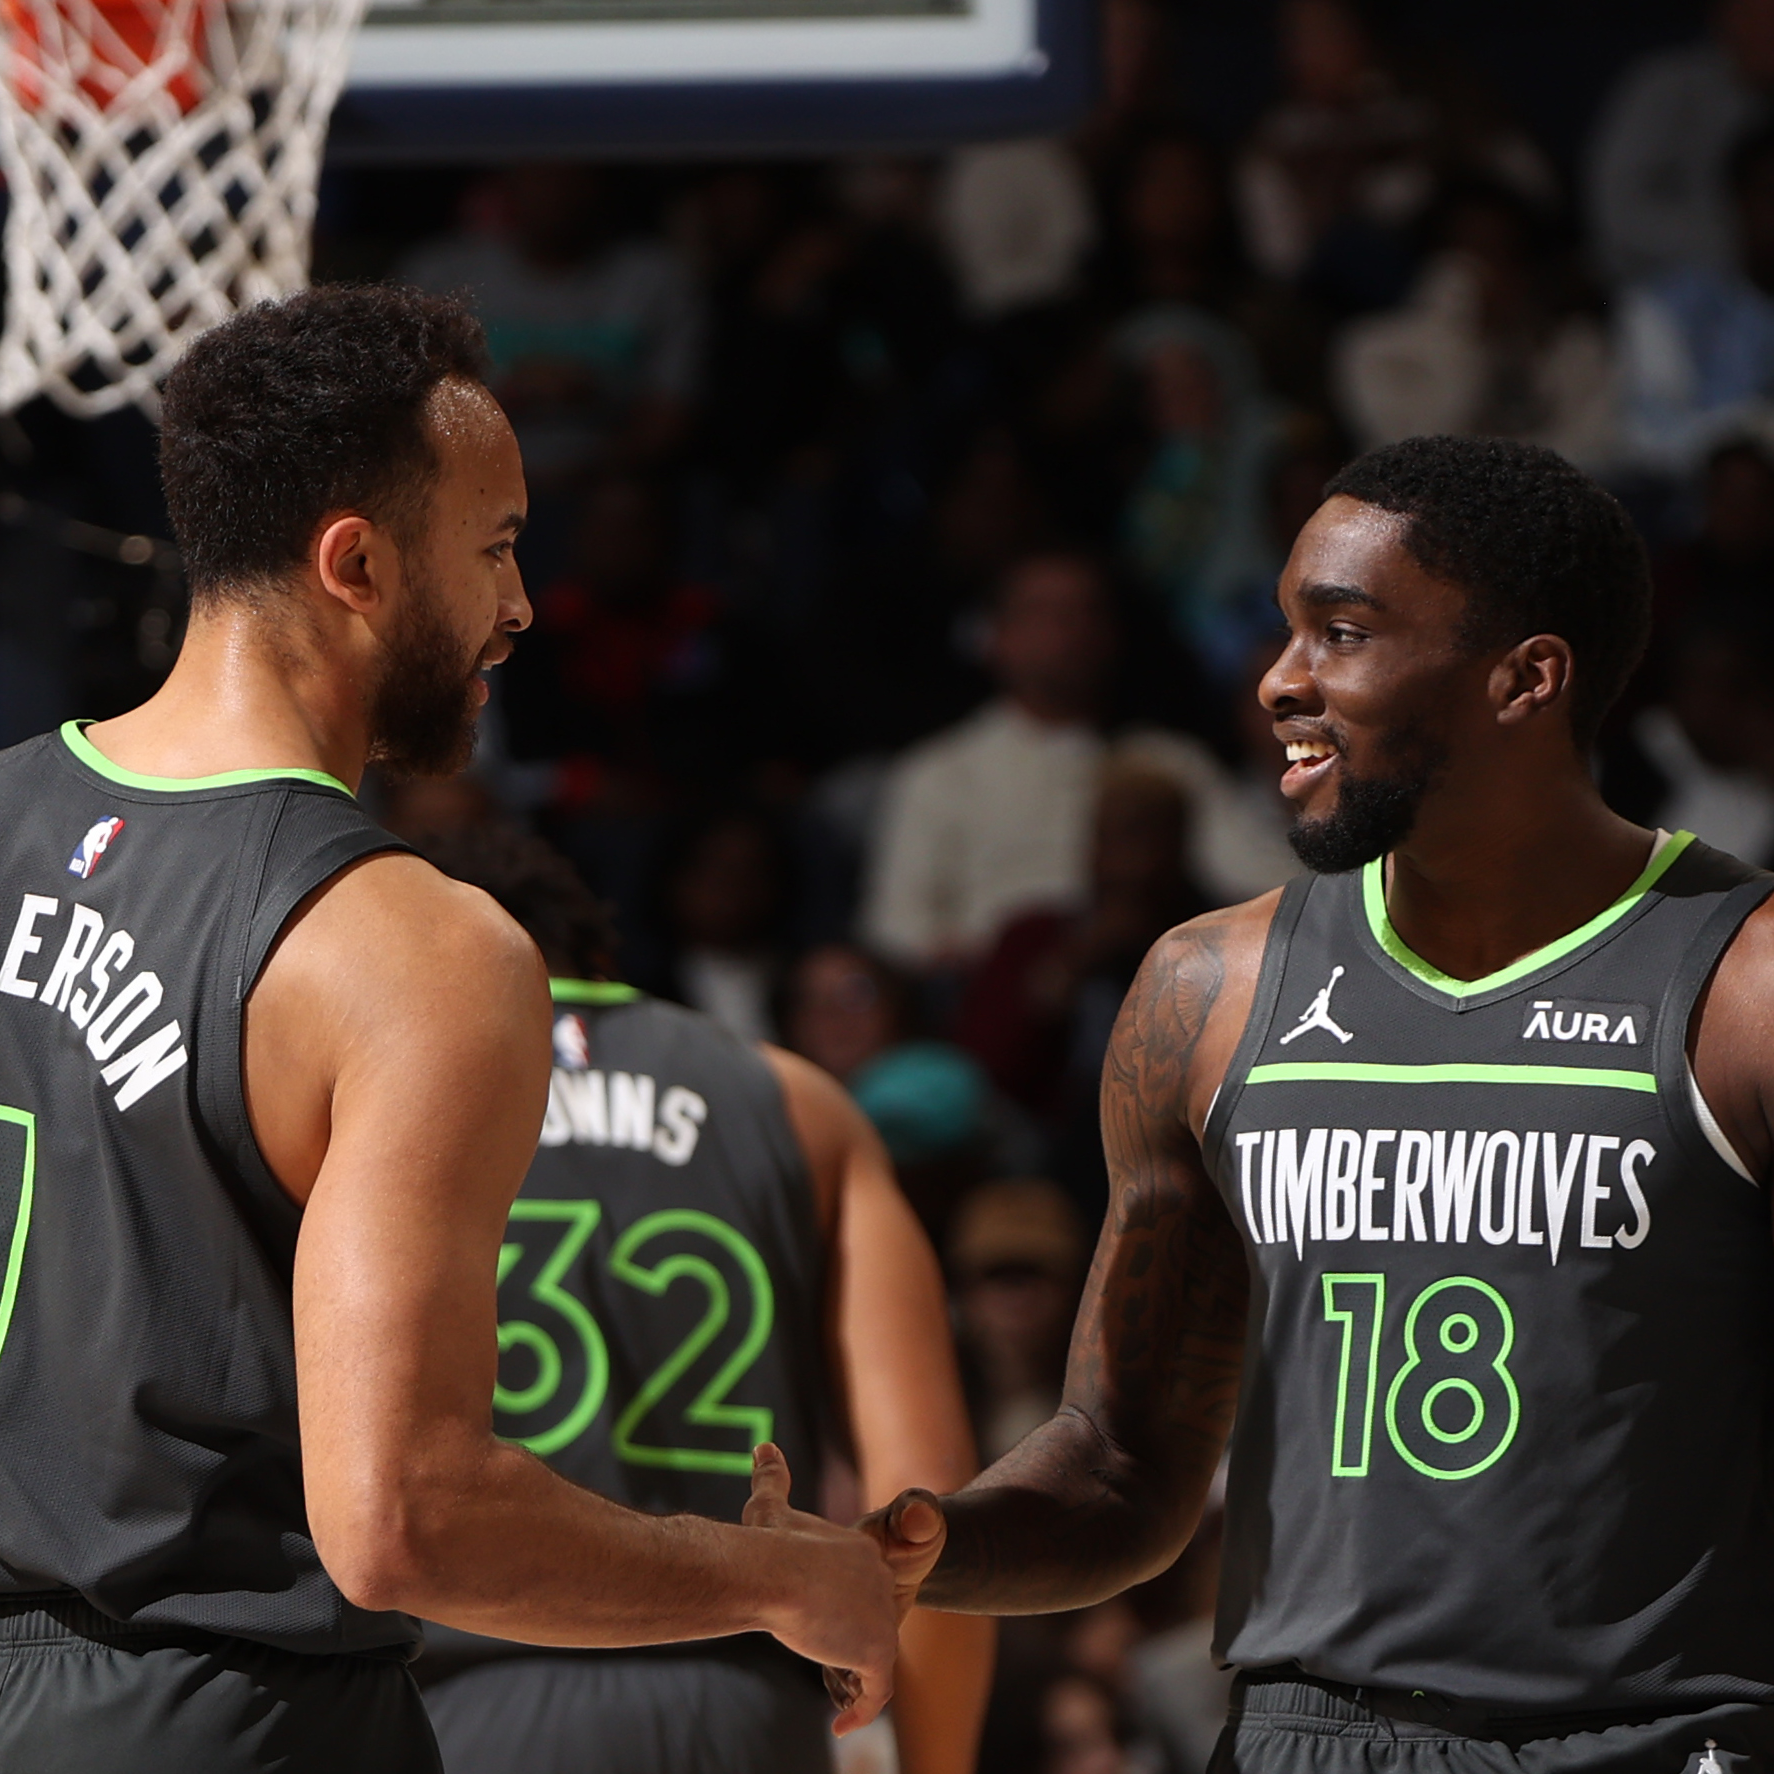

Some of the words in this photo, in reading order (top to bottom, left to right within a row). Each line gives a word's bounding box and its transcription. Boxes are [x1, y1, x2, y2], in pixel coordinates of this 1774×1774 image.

[1235, 1127, 1658, 1267] TIMBERWOLVES
[491, 1198, 776, 1477] 32
[1321, 1272, 1521, 1481] 18
